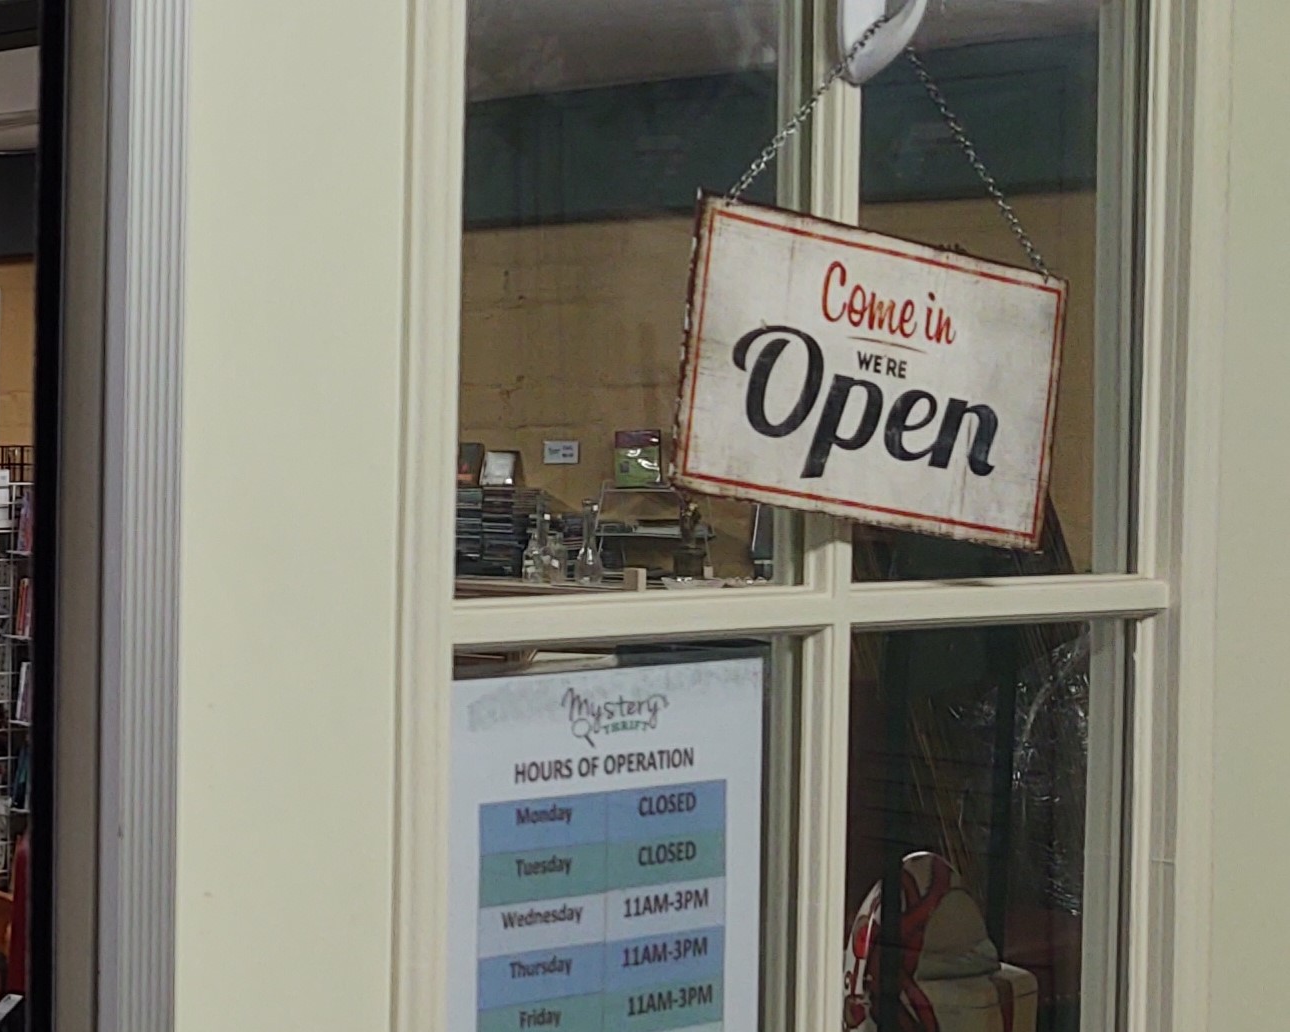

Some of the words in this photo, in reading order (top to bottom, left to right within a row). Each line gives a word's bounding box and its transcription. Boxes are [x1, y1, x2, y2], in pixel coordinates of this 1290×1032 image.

[821, 260, 917, 340] Come
[924, 292, 957, 345] in
[732, 324, 999, 479] Open
[561, 687, 669, 735] Mystery
[514, 757, 573, 785] HOURS
[577, 756, 600, 778] OF
[603, 747, 695, 775] OPERATION
[515, 803, 573, 826] Monday
[637, 791, 697, 818] CLOSED
[515, 854, 573, 877] Tuesday
[637, 840, 697, 867] CLOSED
[501, 903, 584, 931] Wednesday
[623, 887, 710, 919] 11AM-3PM
[509, 957, 573, 980] Thursday
[622, 936, 708, 968] 11AM-3PM
[519, 1009, 562, 1029] Friday
[627, 984, 714, 1017] 11AM-3PM
